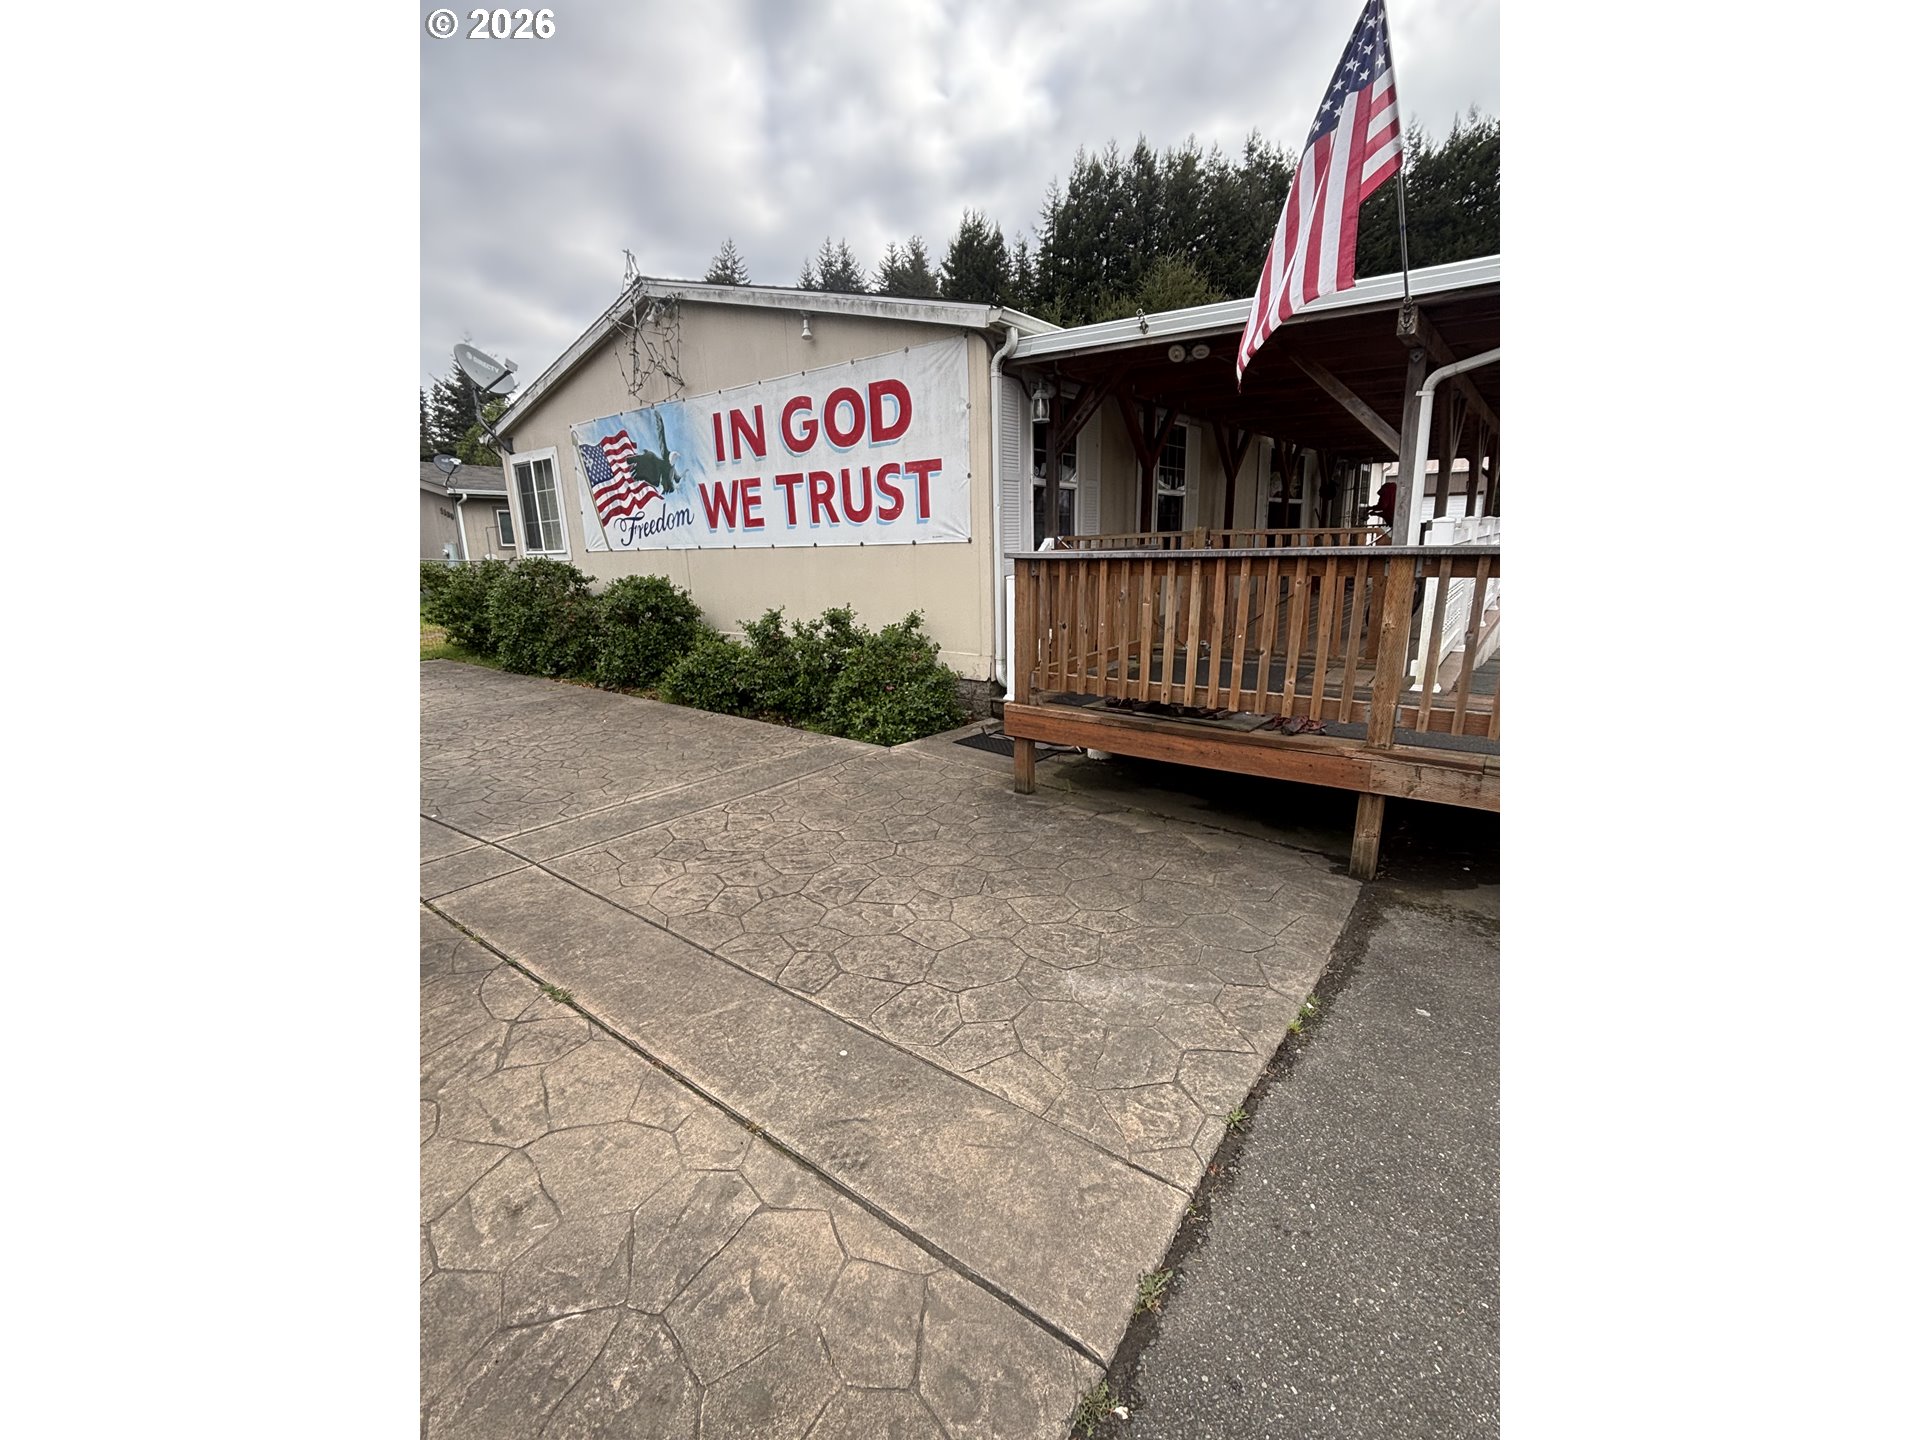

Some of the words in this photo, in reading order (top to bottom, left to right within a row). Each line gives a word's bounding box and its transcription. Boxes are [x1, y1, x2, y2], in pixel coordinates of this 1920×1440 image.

[711, 404, 767, 463] IN
[780, 378, 913, 455] GOD
[613, 503, 695, 547] Freedom
[697, 476, 766, 531] WE
[774, 457, 943, 527] TRUST
